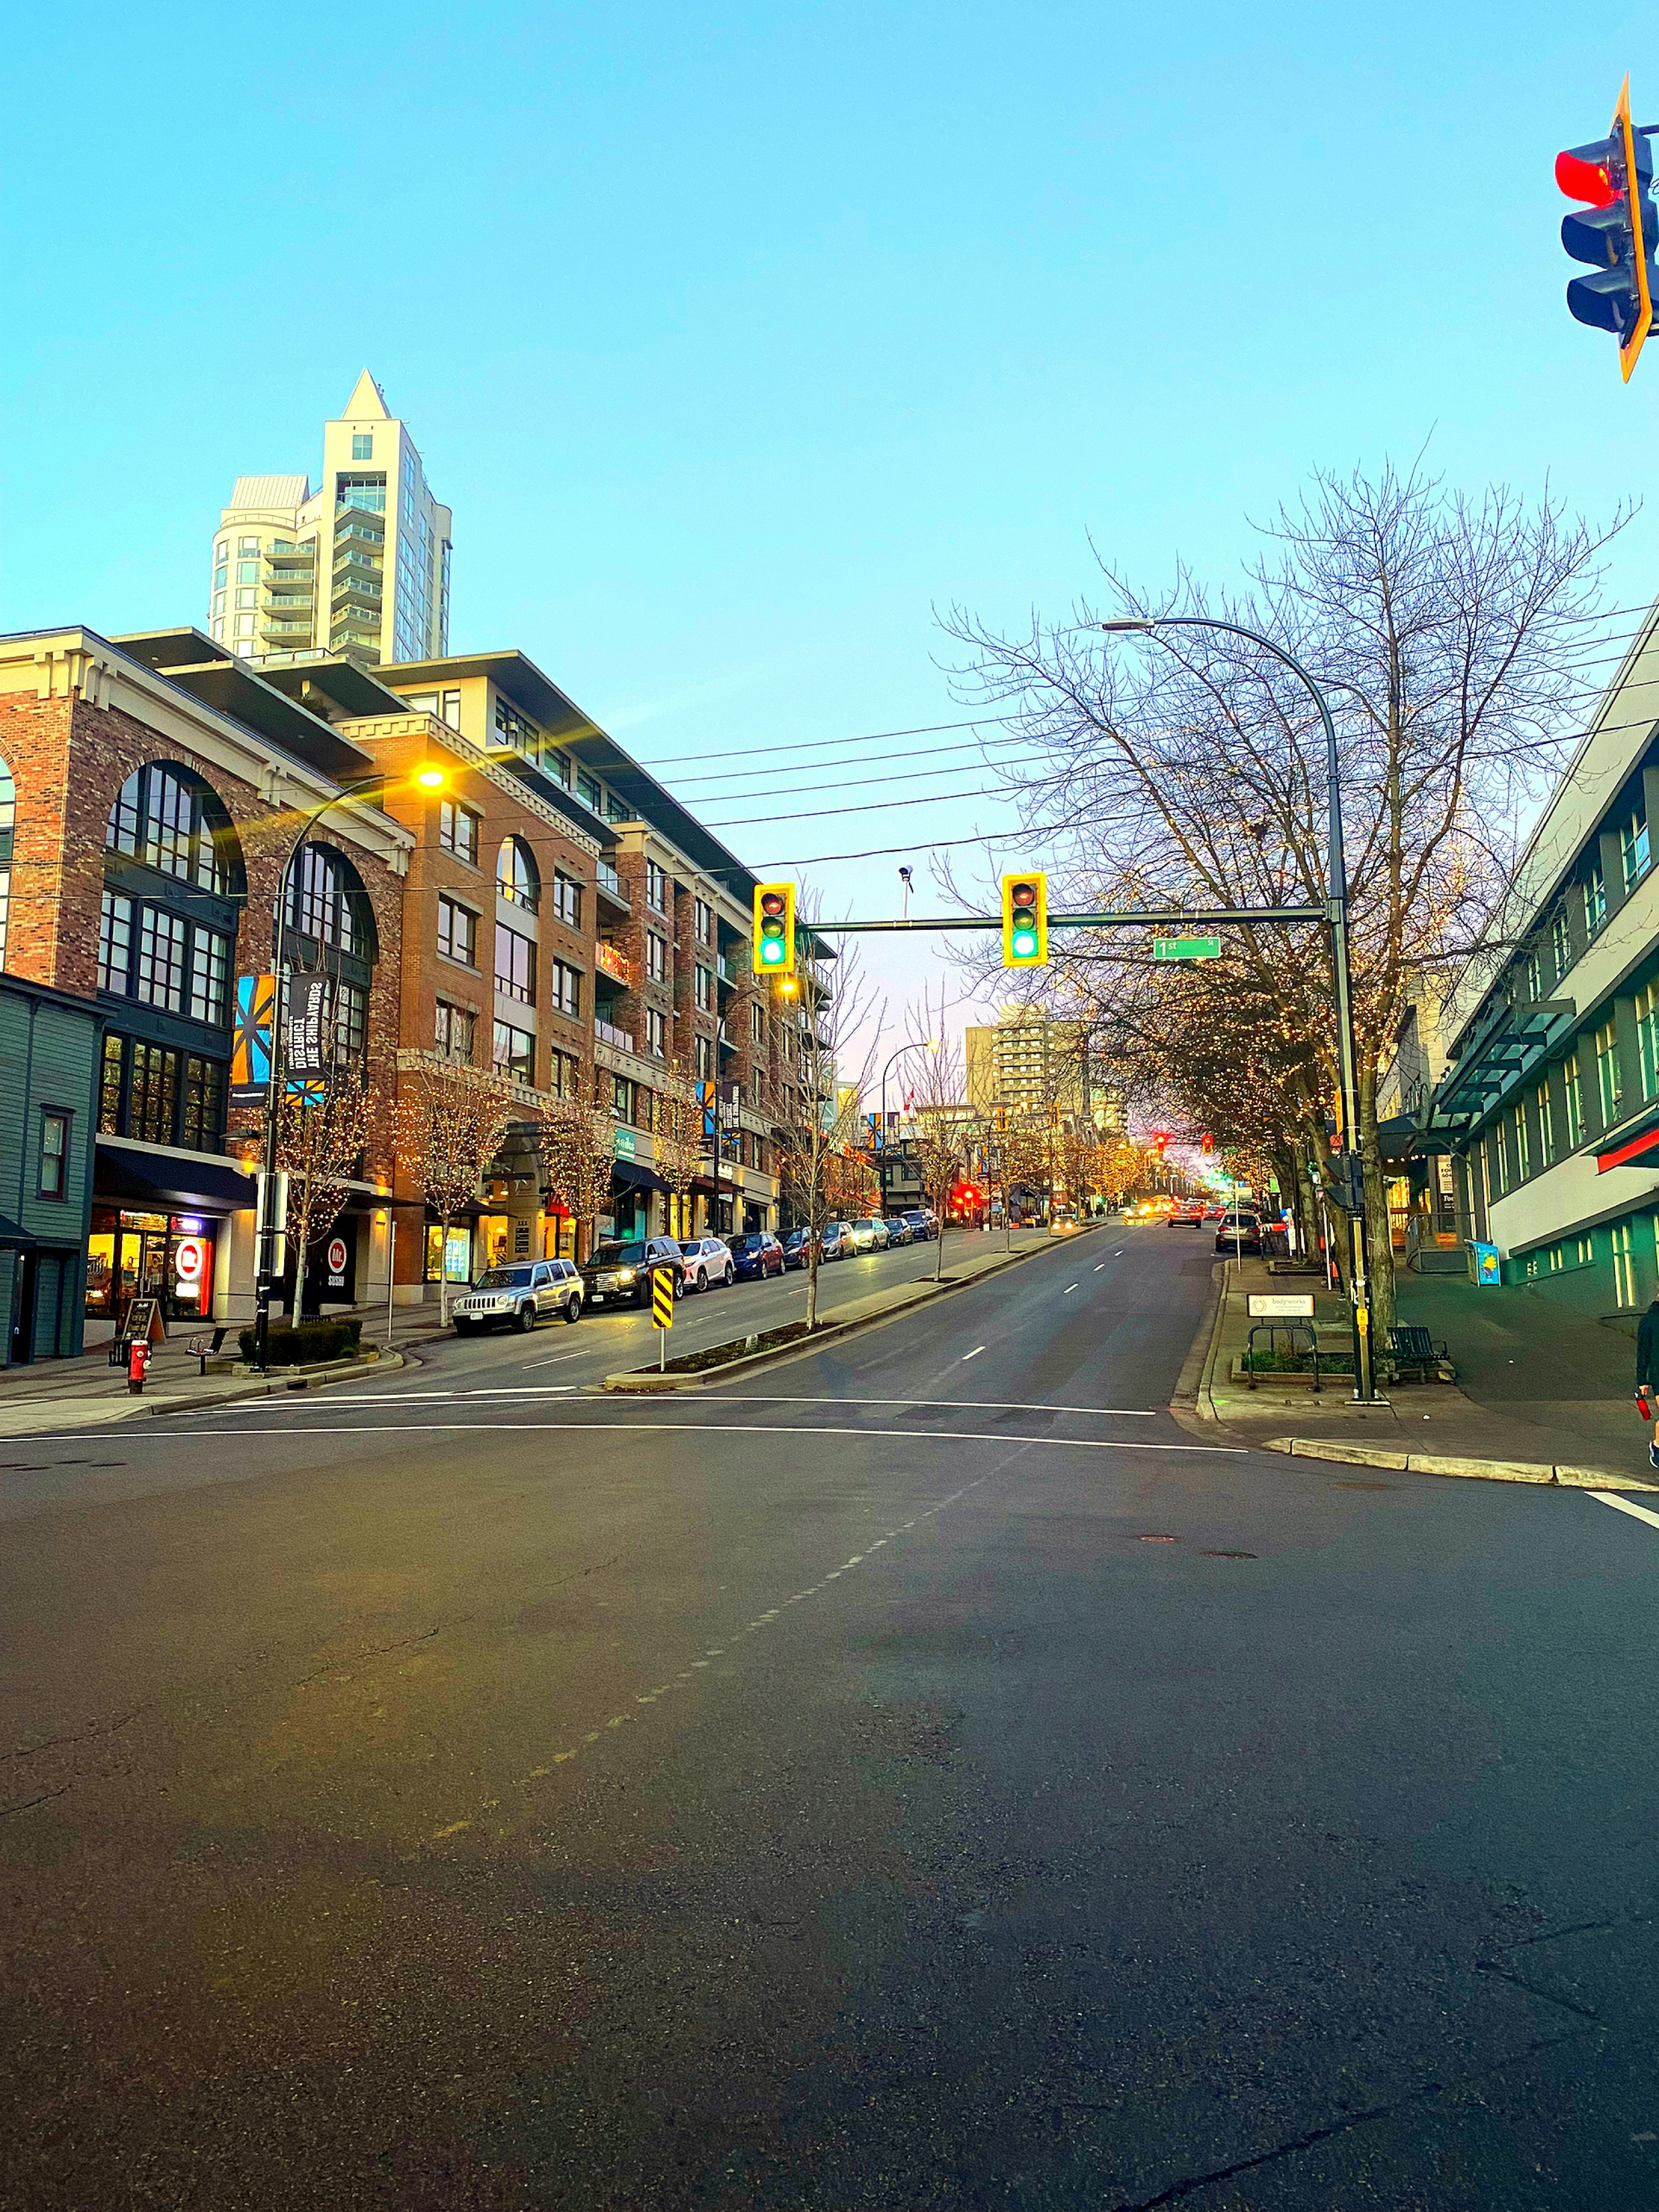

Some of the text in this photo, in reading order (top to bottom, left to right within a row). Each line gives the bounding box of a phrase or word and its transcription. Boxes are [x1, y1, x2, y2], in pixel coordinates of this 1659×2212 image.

[1159, 941, 1177, 956] 1st
[332, 1248, 343, 1262] Mr.
[328, 1275, 344, 1287] SUSHI
